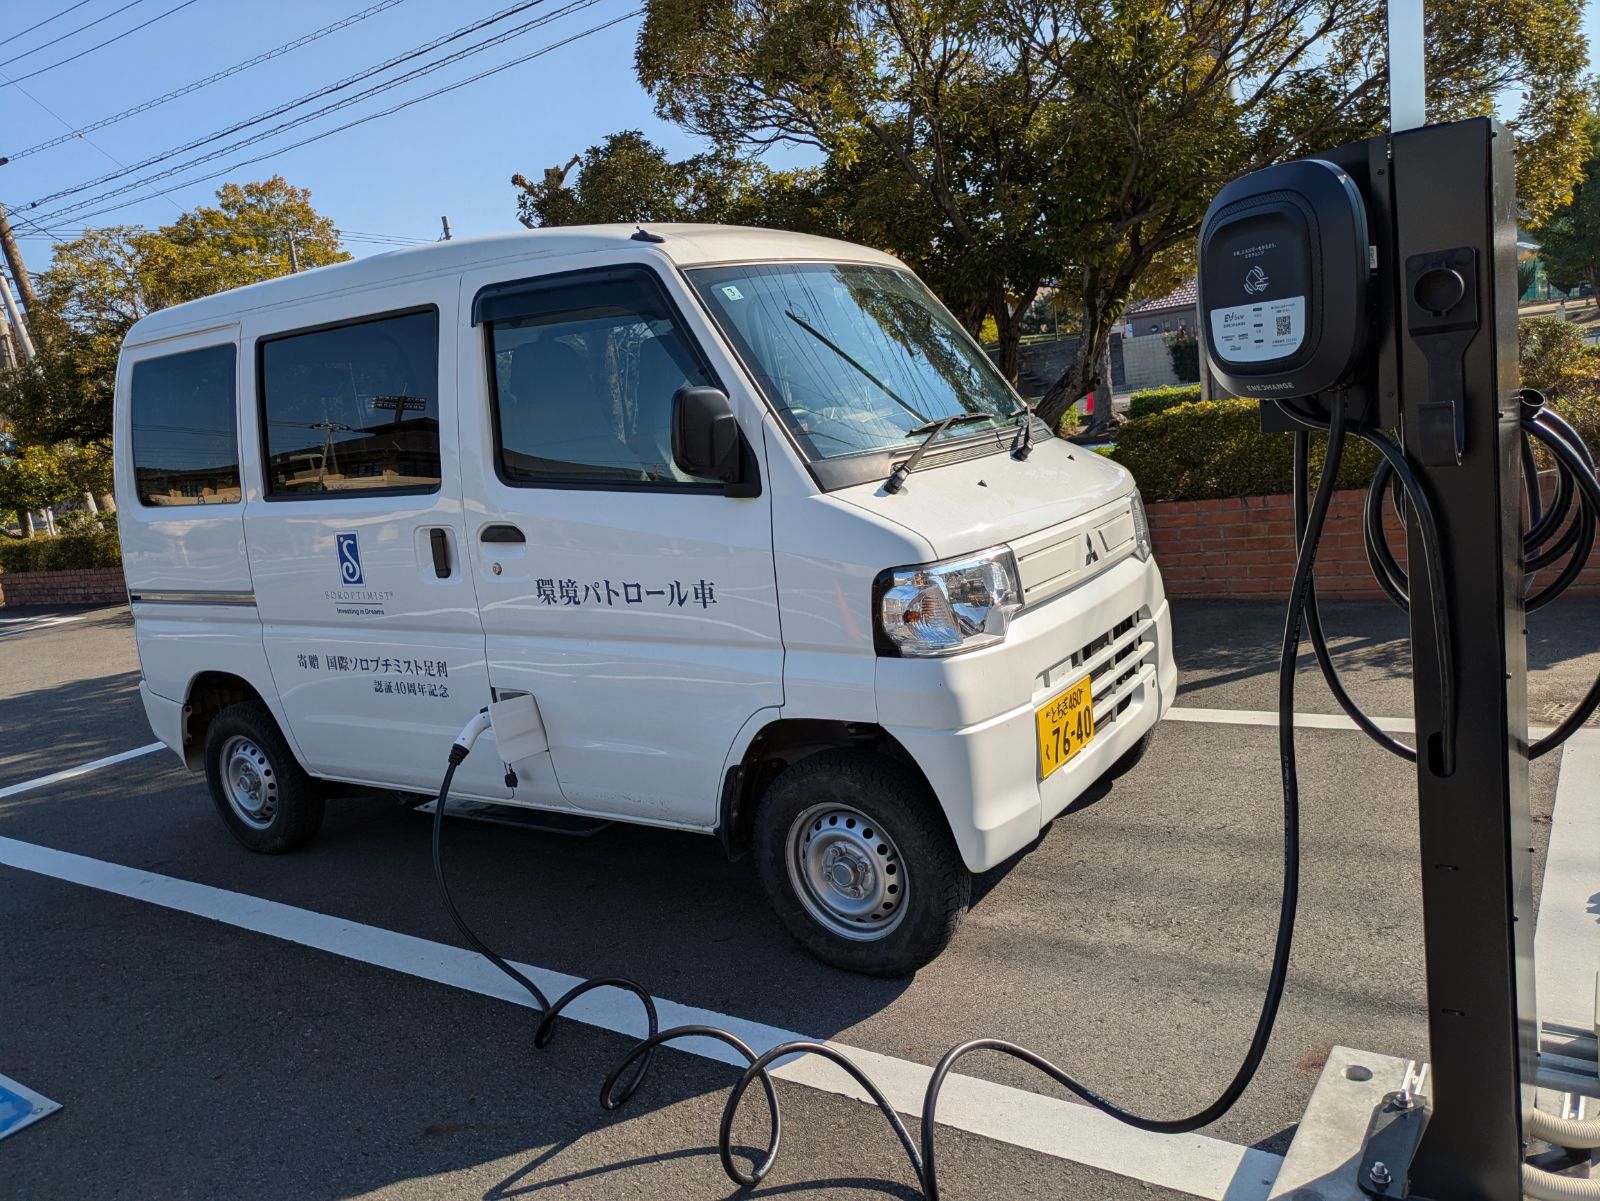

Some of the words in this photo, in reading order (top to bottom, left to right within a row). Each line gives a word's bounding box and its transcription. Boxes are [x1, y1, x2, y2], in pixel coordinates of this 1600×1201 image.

[535, 578, 718, 609] 環境パトロール車
[336, 607, 360, 616] Investing
[297, 654, 320, 670] 寄贈
[374, 679, 450, 698] 認証40周年記念
[1051, 697, 1069, 724] とちぎ
[1068, 688, 1082, 711] 480
[1052, 705, 1092, 764] 76-40
